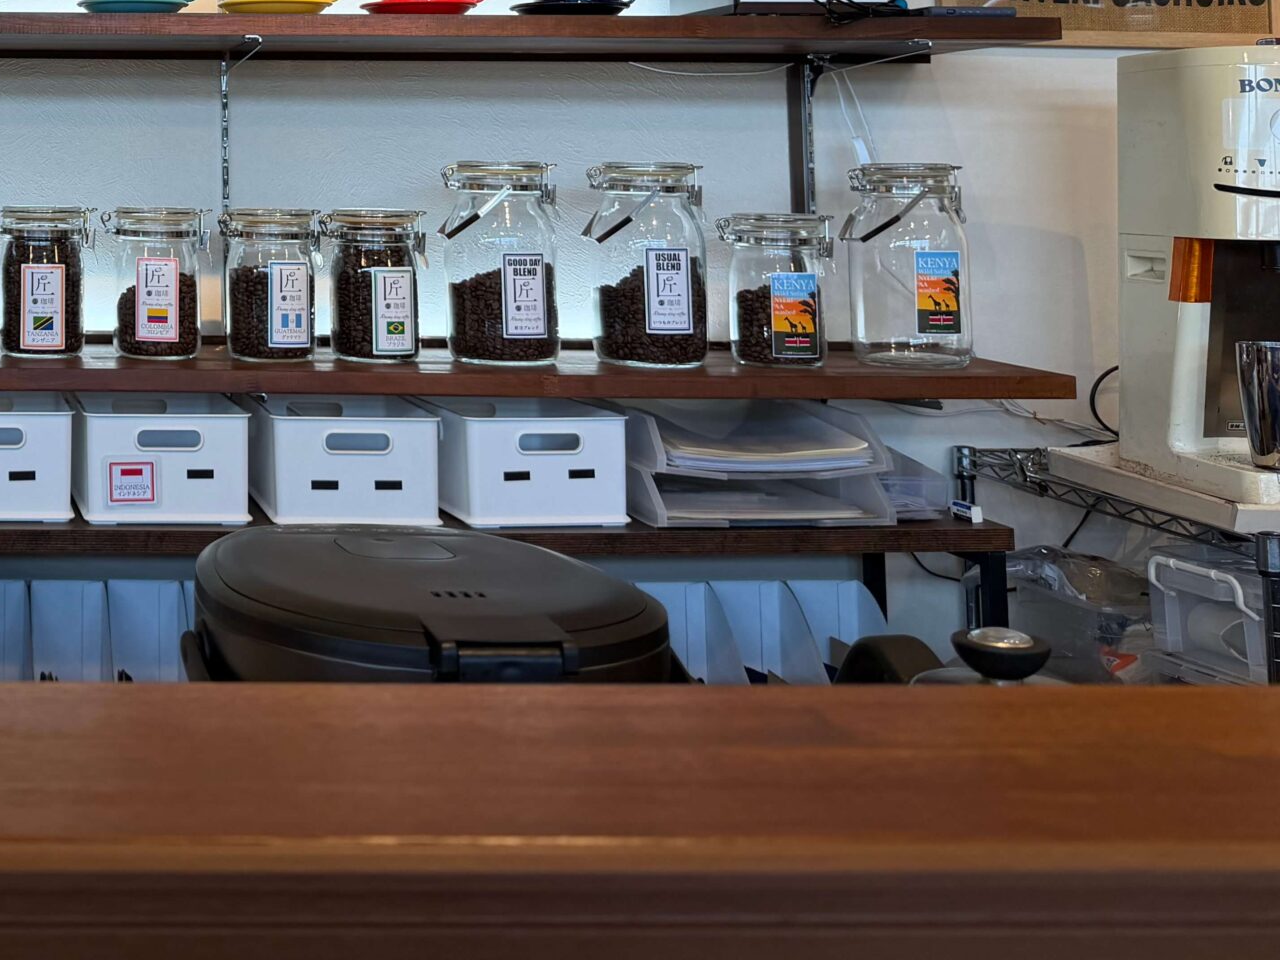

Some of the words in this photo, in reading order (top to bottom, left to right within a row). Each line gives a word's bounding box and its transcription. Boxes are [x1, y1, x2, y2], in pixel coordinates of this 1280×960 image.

[655, 253, 681, 261] USUAL
[507, 258, 528, 266] GOOD
[529, 258, 540, 266] DAY
[918, 257, 958, 268] KENYA
[656, 262, 681, 271] BLEND
[513, 268, 537, 276] BLEND
[774, 280, 815, 290] KENYA
